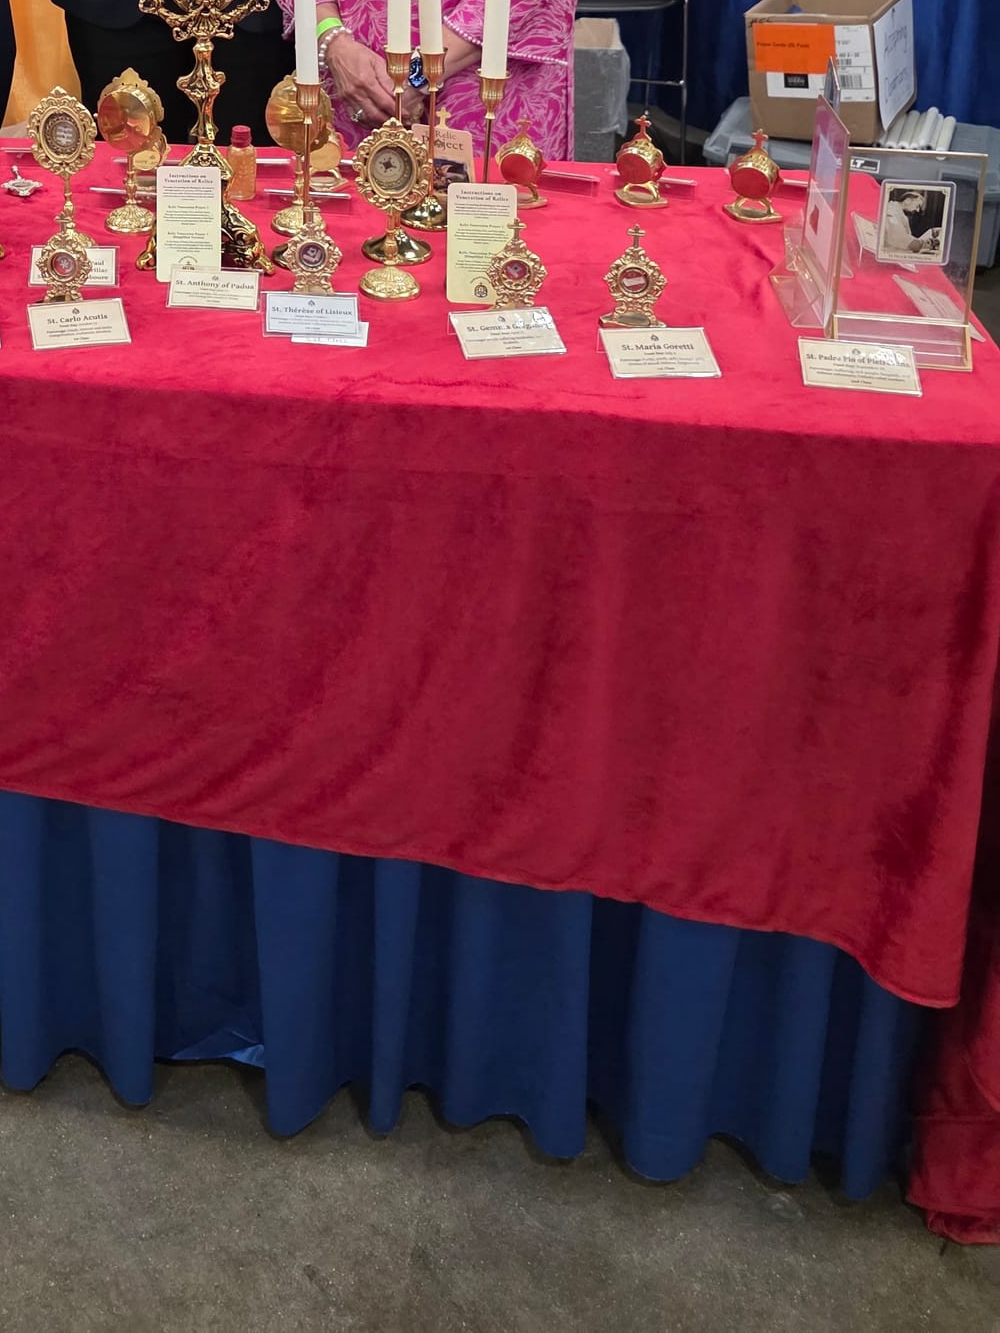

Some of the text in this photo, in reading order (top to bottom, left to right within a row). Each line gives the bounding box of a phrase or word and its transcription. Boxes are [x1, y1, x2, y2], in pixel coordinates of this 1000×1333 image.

[420, 135, 464, 150] Poject
[187, 280, 219, 289] Anthony
[83, 313, 108, 321] Acutis
[635, 343, 662, 351] Maria
[663, 342, 695, 351] Goretti
